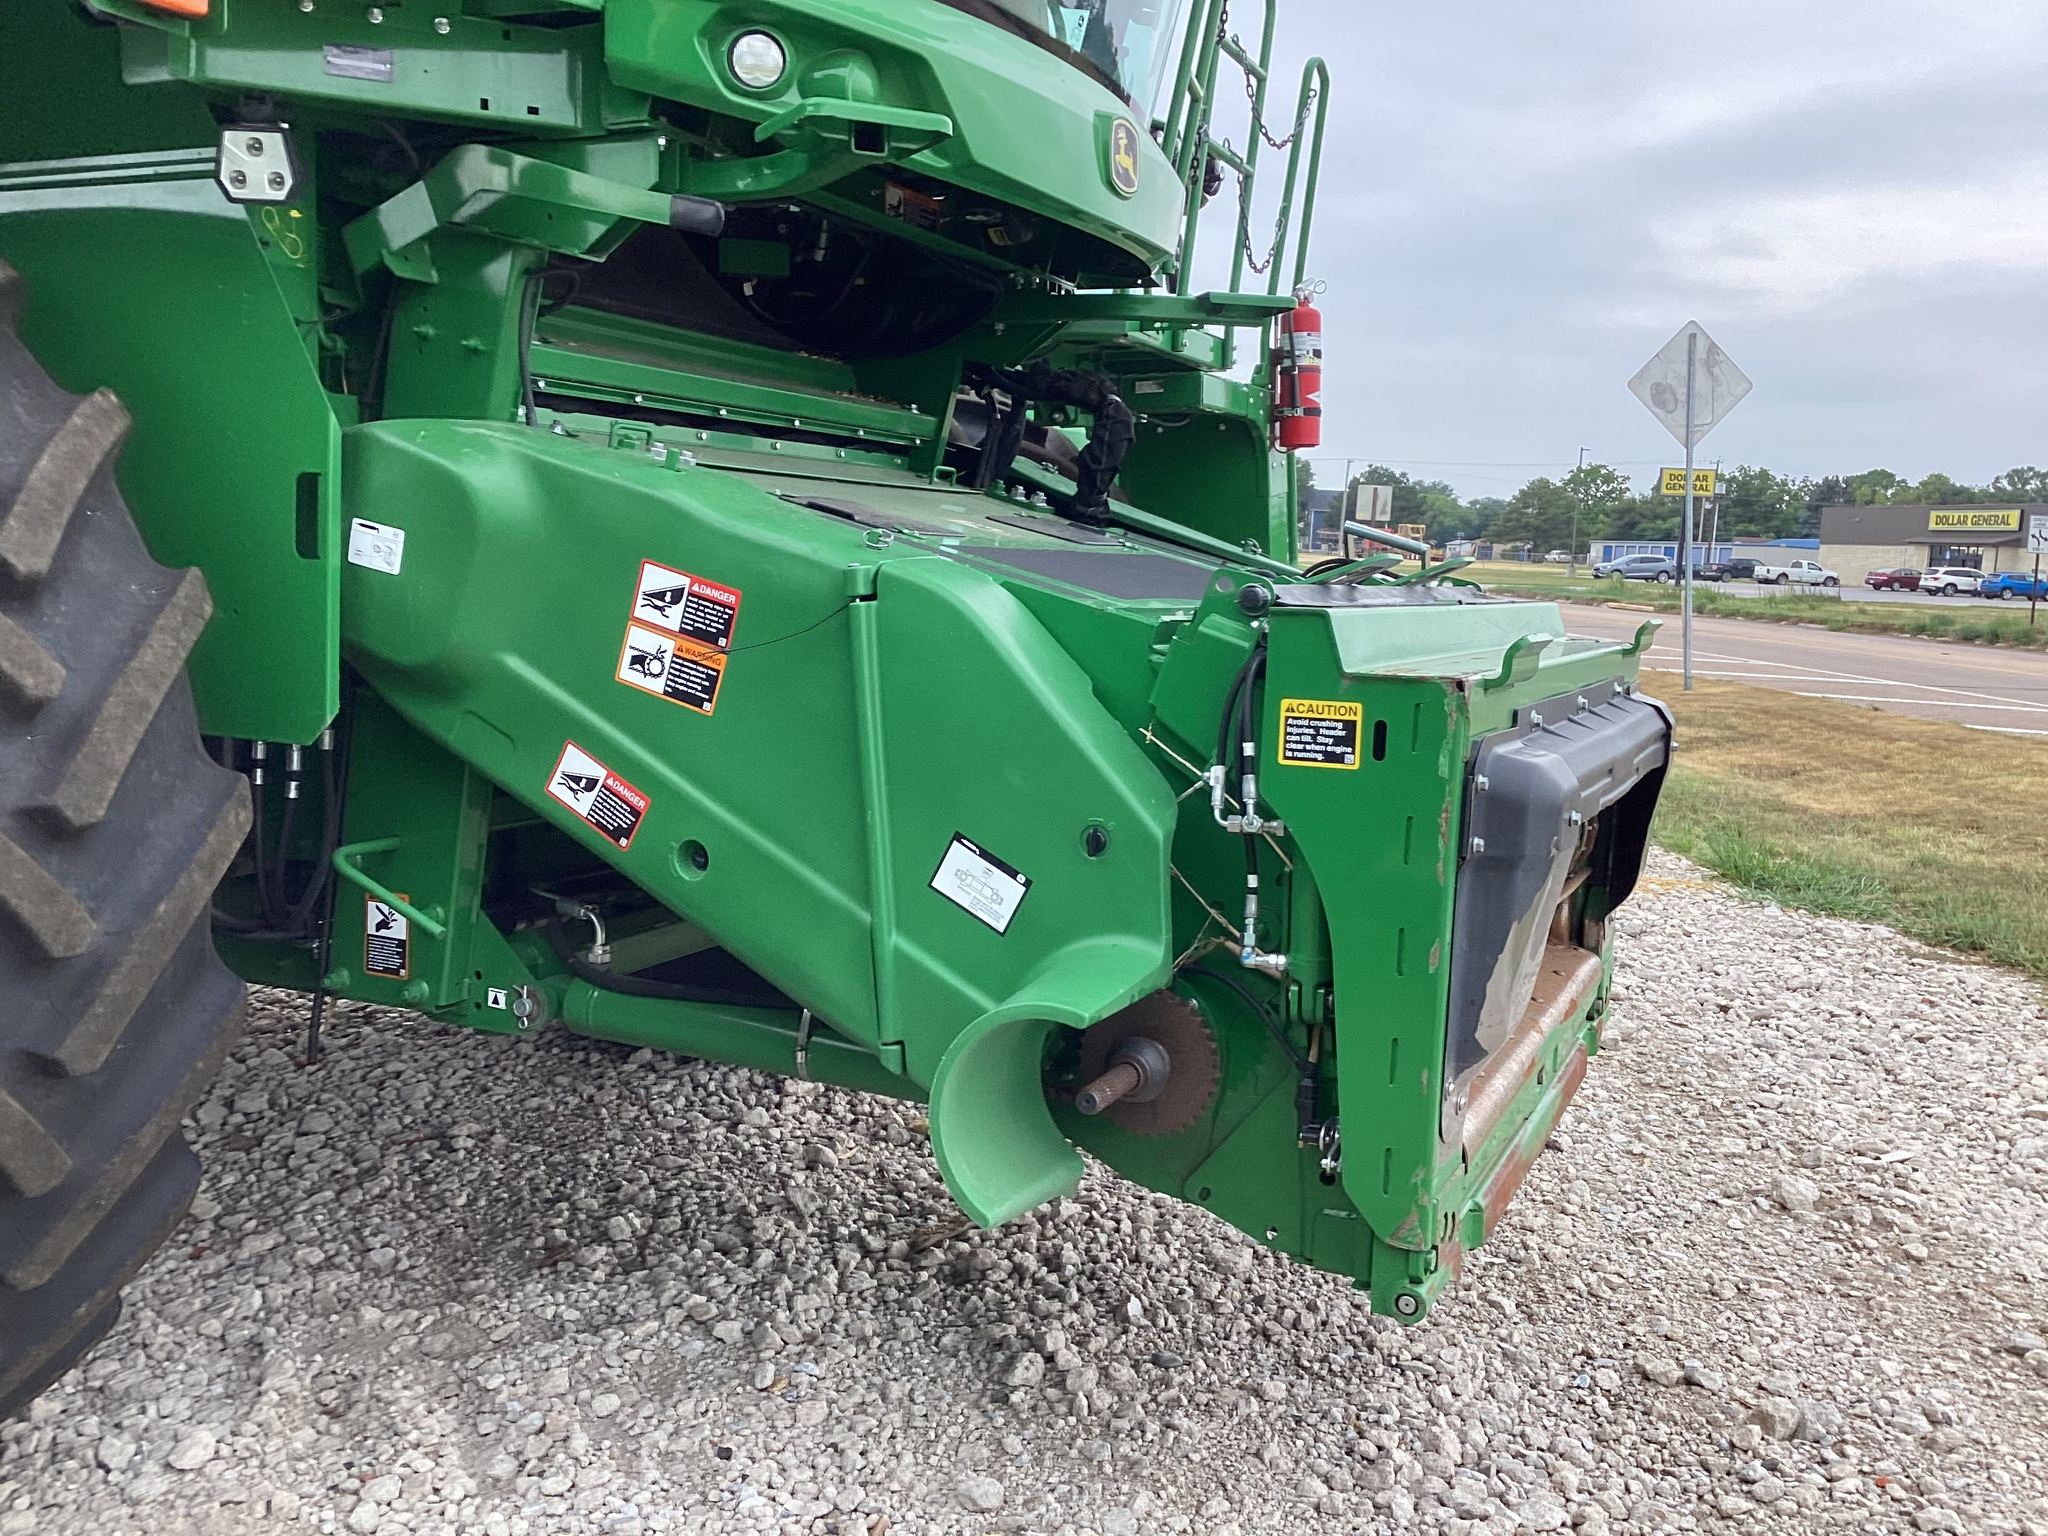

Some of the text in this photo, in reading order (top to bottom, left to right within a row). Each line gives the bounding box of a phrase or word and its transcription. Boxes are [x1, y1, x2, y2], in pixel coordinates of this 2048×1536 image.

[1670, 474, 1708, 482] DOAR
[1666, 482, 1710, 492] GENRAL
[1936, 514, 2010, 526] DOLLAR GENERAL
[700, 584, 736, 604] DANGER
[684, 646, 722, 666] WARNING
[1296, 704, 1358, 716] CAUTION
[1286, 718, 1342, 730] Avoid crushing
[1316, 736, 1334, 744] Stay
[1294, 752, 1324, 760] running.
[1326, 746, 1352, 754] engine
[612, 782, 646, 810] DANGER
